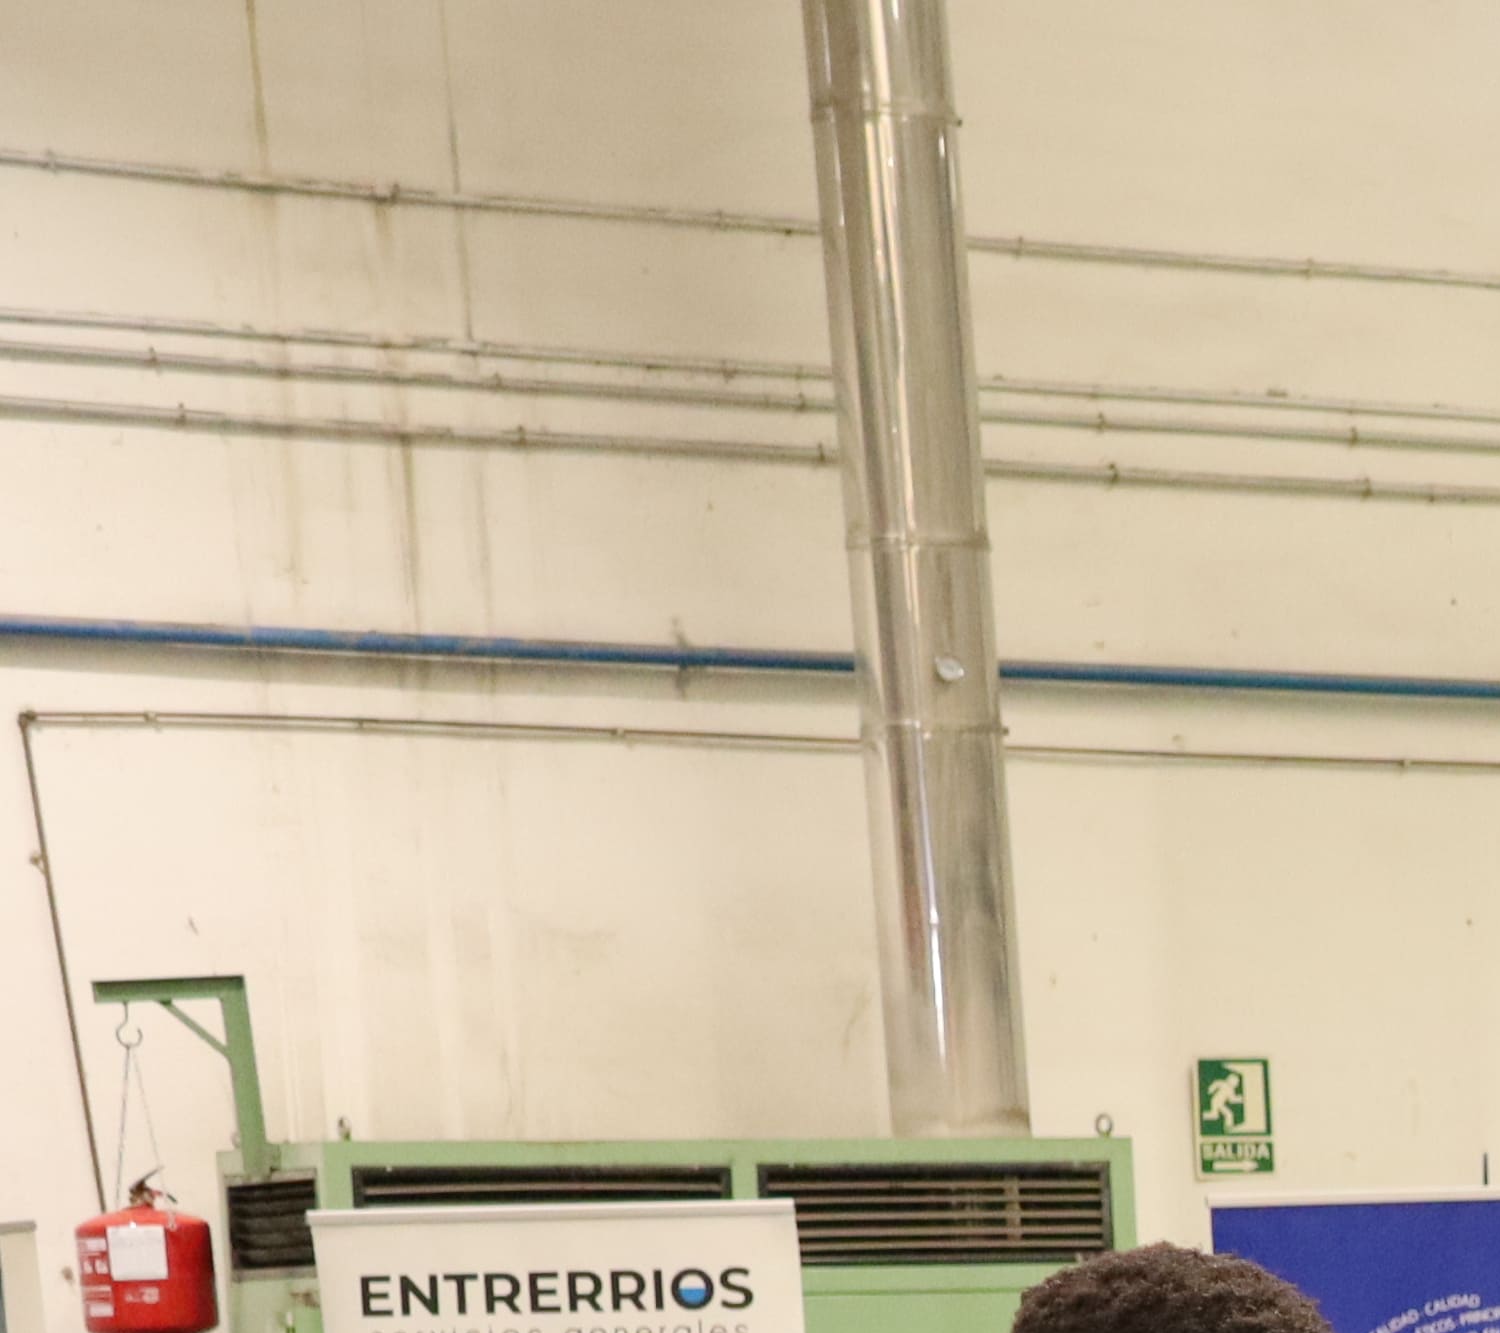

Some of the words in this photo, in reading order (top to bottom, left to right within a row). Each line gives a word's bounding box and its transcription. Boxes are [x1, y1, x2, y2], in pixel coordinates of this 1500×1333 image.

[1202, 1143, 1270, 1161] SALIDA
[360, 1268, 753, 1317] ENTRERRIOS
[1424, 1293, 1480, 1316] CALIDAD
